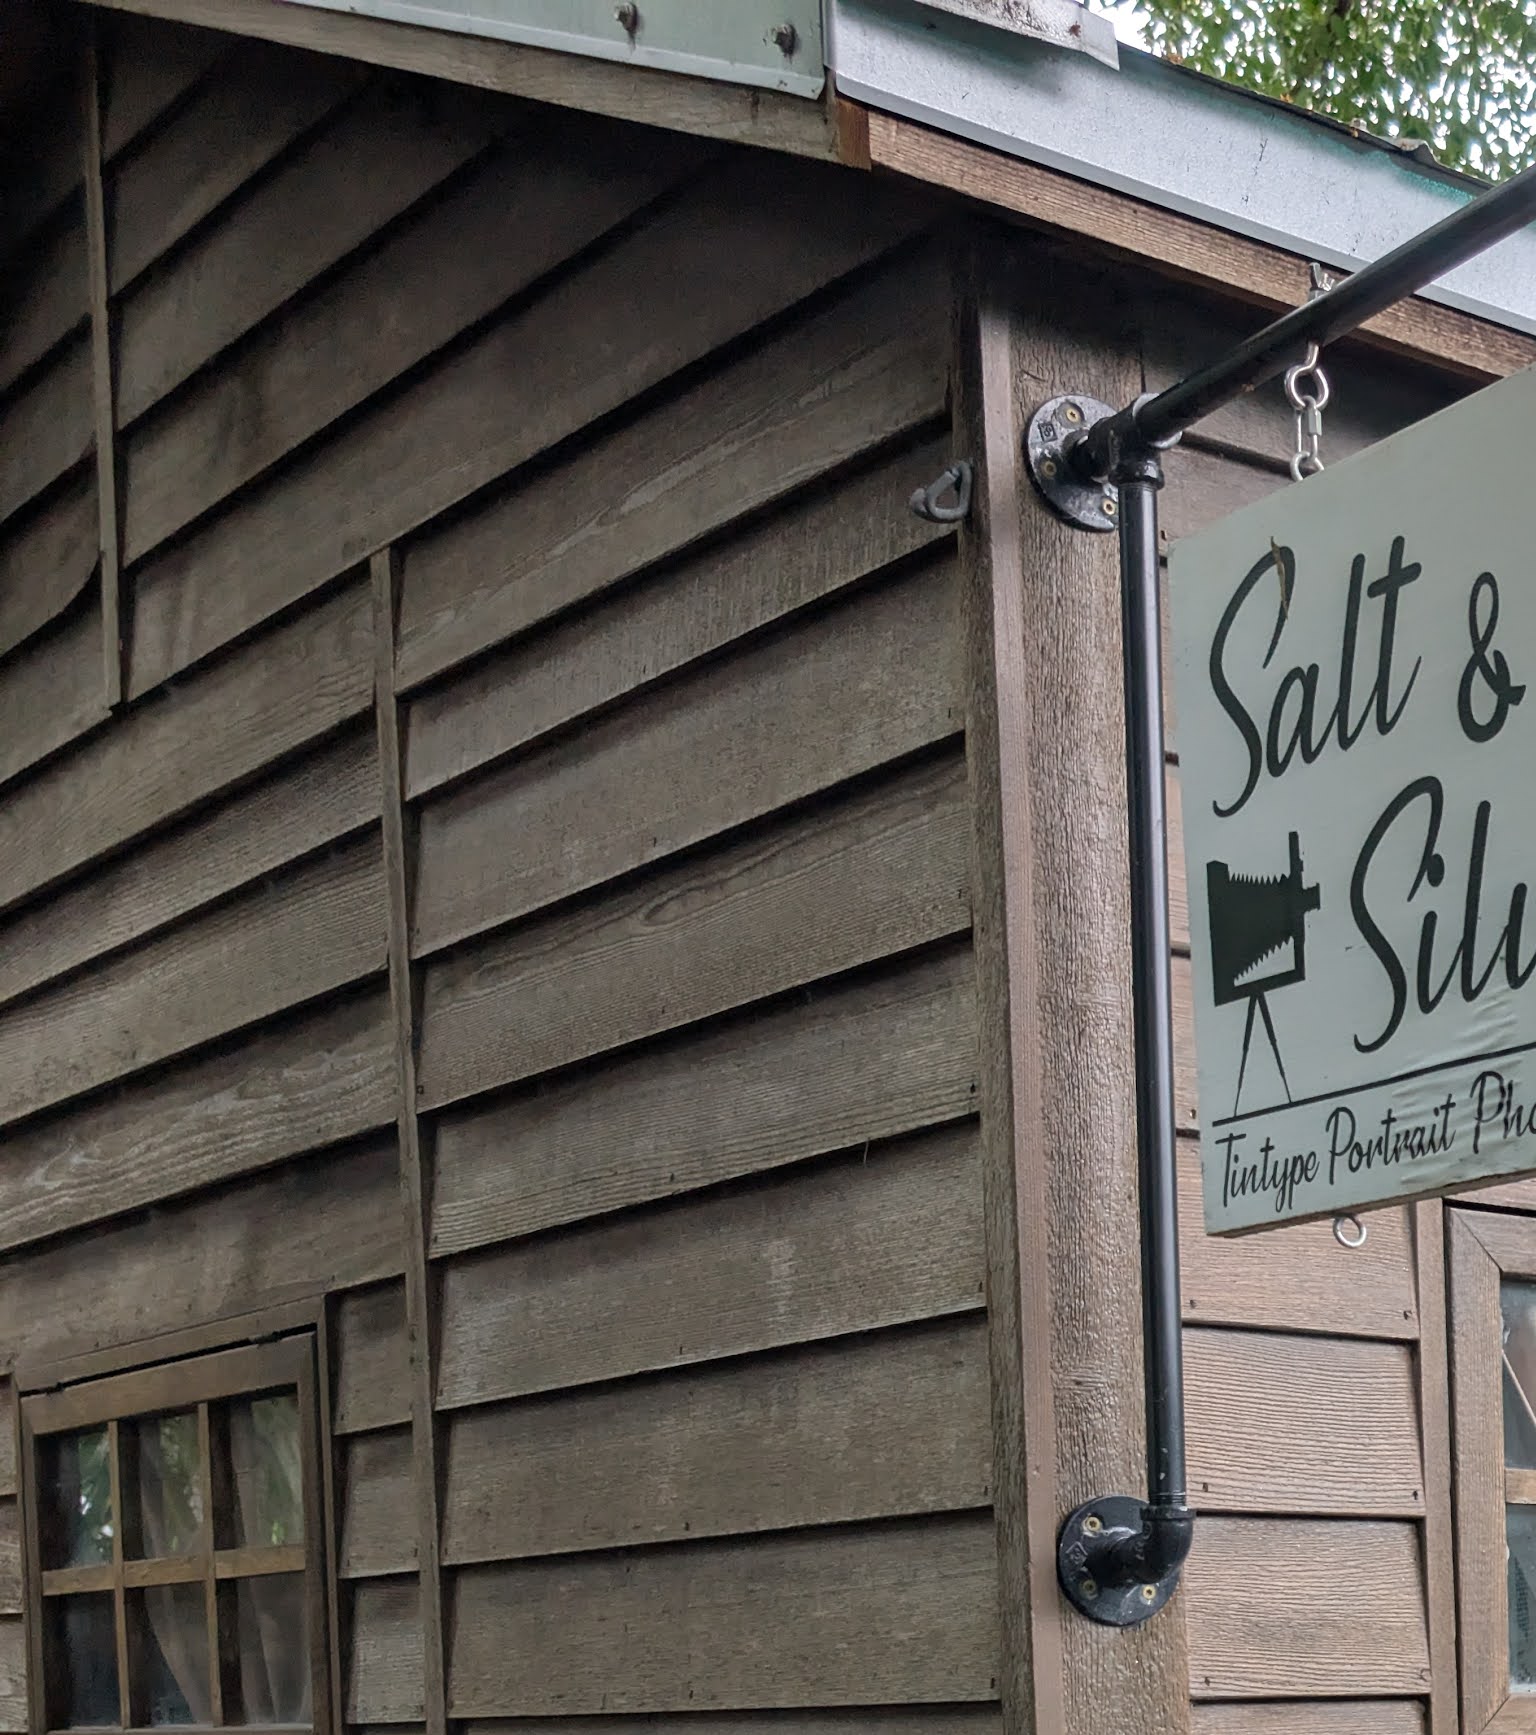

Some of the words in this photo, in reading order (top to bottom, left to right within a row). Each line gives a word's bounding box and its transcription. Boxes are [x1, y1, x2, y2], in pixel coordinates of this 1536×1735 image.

[1209, 535, 1422, 818] Salt
[1457, 571, 1527, 744] &
[1215, 1132, 1321, 1213] Tintype
[1325, 1092, 1457, 1186] Portrait
